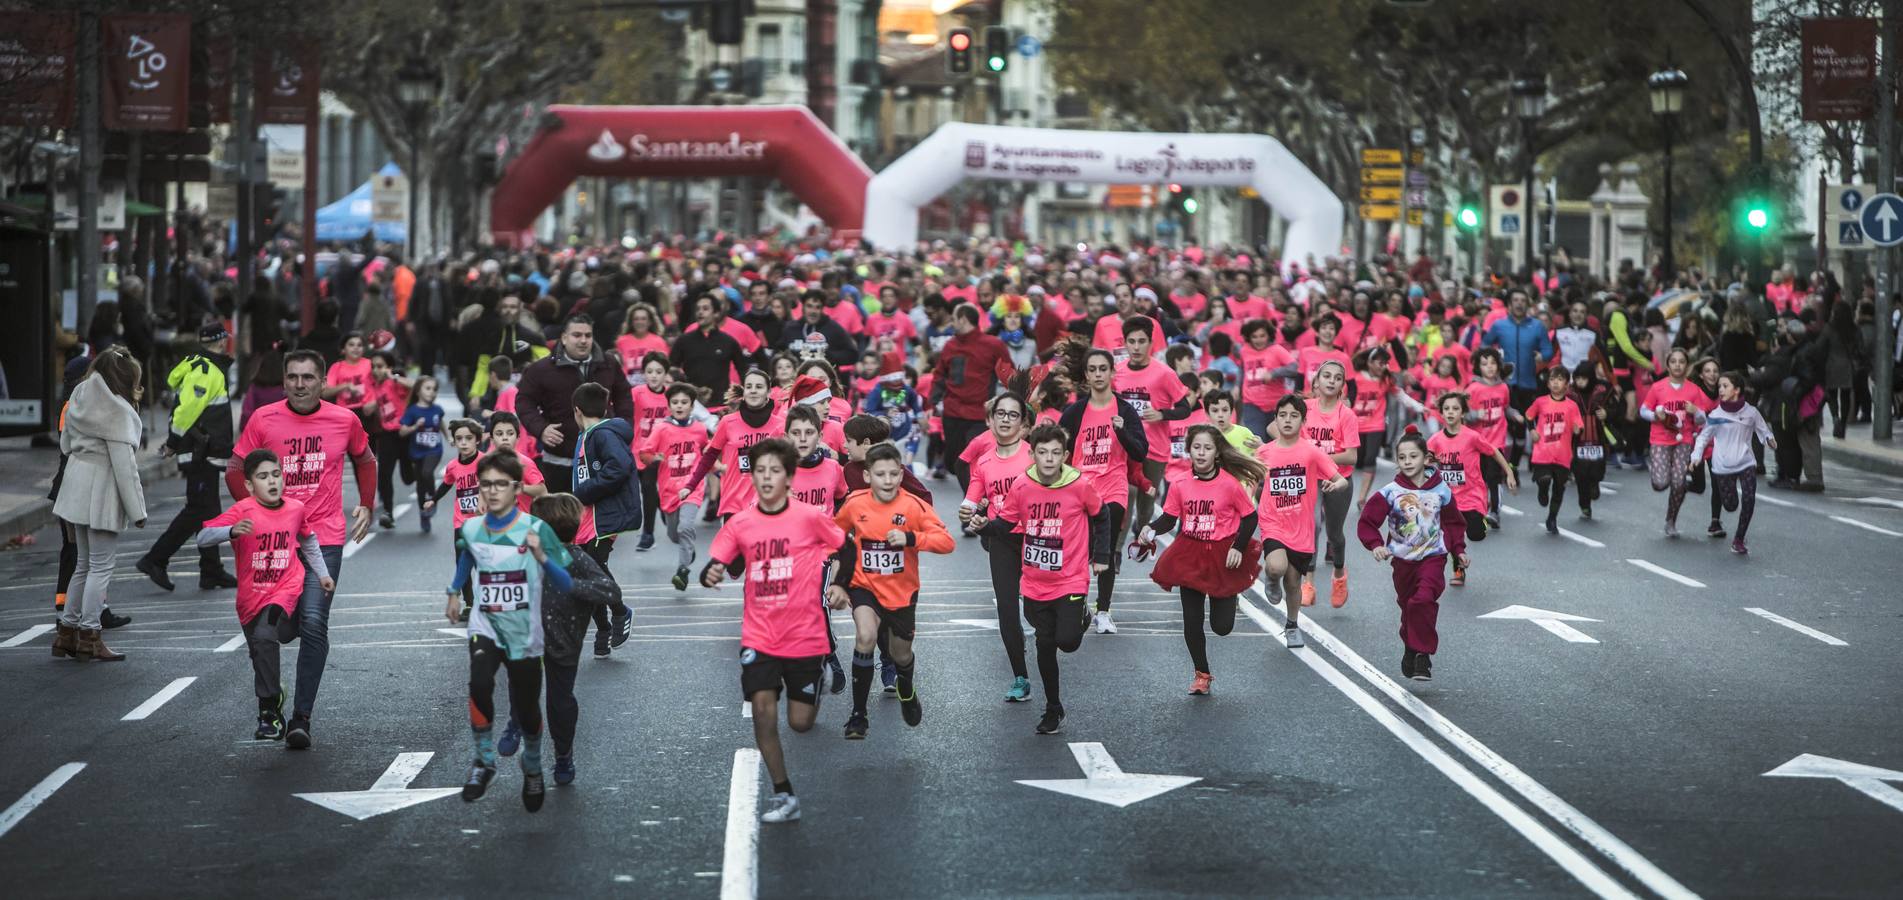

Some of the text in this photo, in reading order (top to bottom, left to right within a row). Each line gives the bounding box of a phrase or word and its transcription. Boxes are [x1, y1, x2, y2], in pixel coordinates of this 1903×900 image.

[629, 131, 769, 160] Santander
[993, 144, 1104, 159] Ayuntamiento
[992, 161, 1009, 171] de
[1097, 424, 1110, 440] DIC
[1320, 427, 1333, 440] DIC
[305, 435, 322, 453] DIC
[283, 455, 290, 464] ES
[305, 453, 318, 462] BUEN
[283, 463, 297, 473] PARA
[303, 461, 319, 471] SALIR
[1272, 477, 1304, 491] 8468
[460, 496, 479, 509] 620
[811, 487, 826, 506] DIC
[1044, 501, 1061, 519] DIC
[1199, 500, 1214, 515] DIC
[1041, 526, 1056, 537] SALIR
[274, 530, 290, 550] DIC
[770, 537, 790, 559] DIC
[864, 552, 900, 568] 8134
[1025, 546, 1058, 565] 6780
[482, 585, 524, 603] 3709
